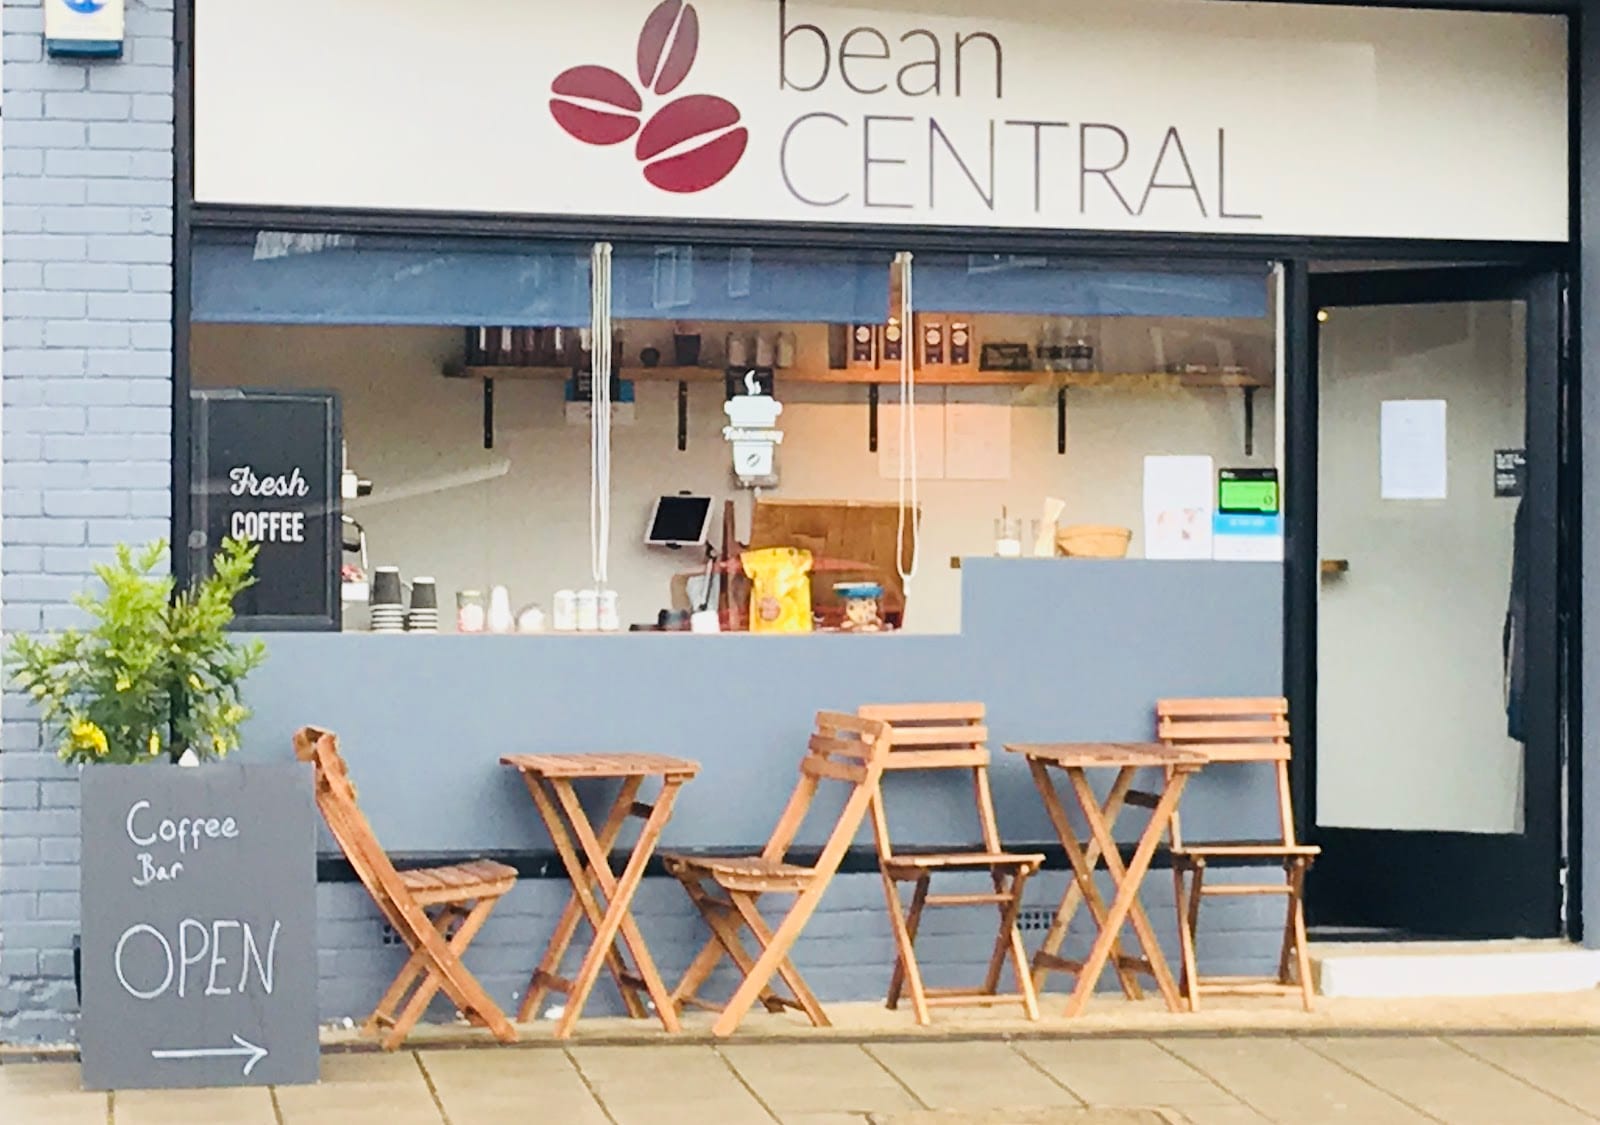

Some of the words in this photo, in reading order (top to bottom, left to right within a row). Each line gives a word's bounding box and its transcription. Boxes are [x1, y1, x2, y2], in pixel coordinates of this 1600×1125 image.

[779, 0, 1003, 98] bean
[780, 113, 1262, 219] CENTRAL
[230, 467, 309, 496] Fresh
[232, 512, 304, 542] COFFEE
[127, 801, 239, 853] Coffee
[133, 854, 183, 885] Bar
[115, 919, 280, 999] OPEN
